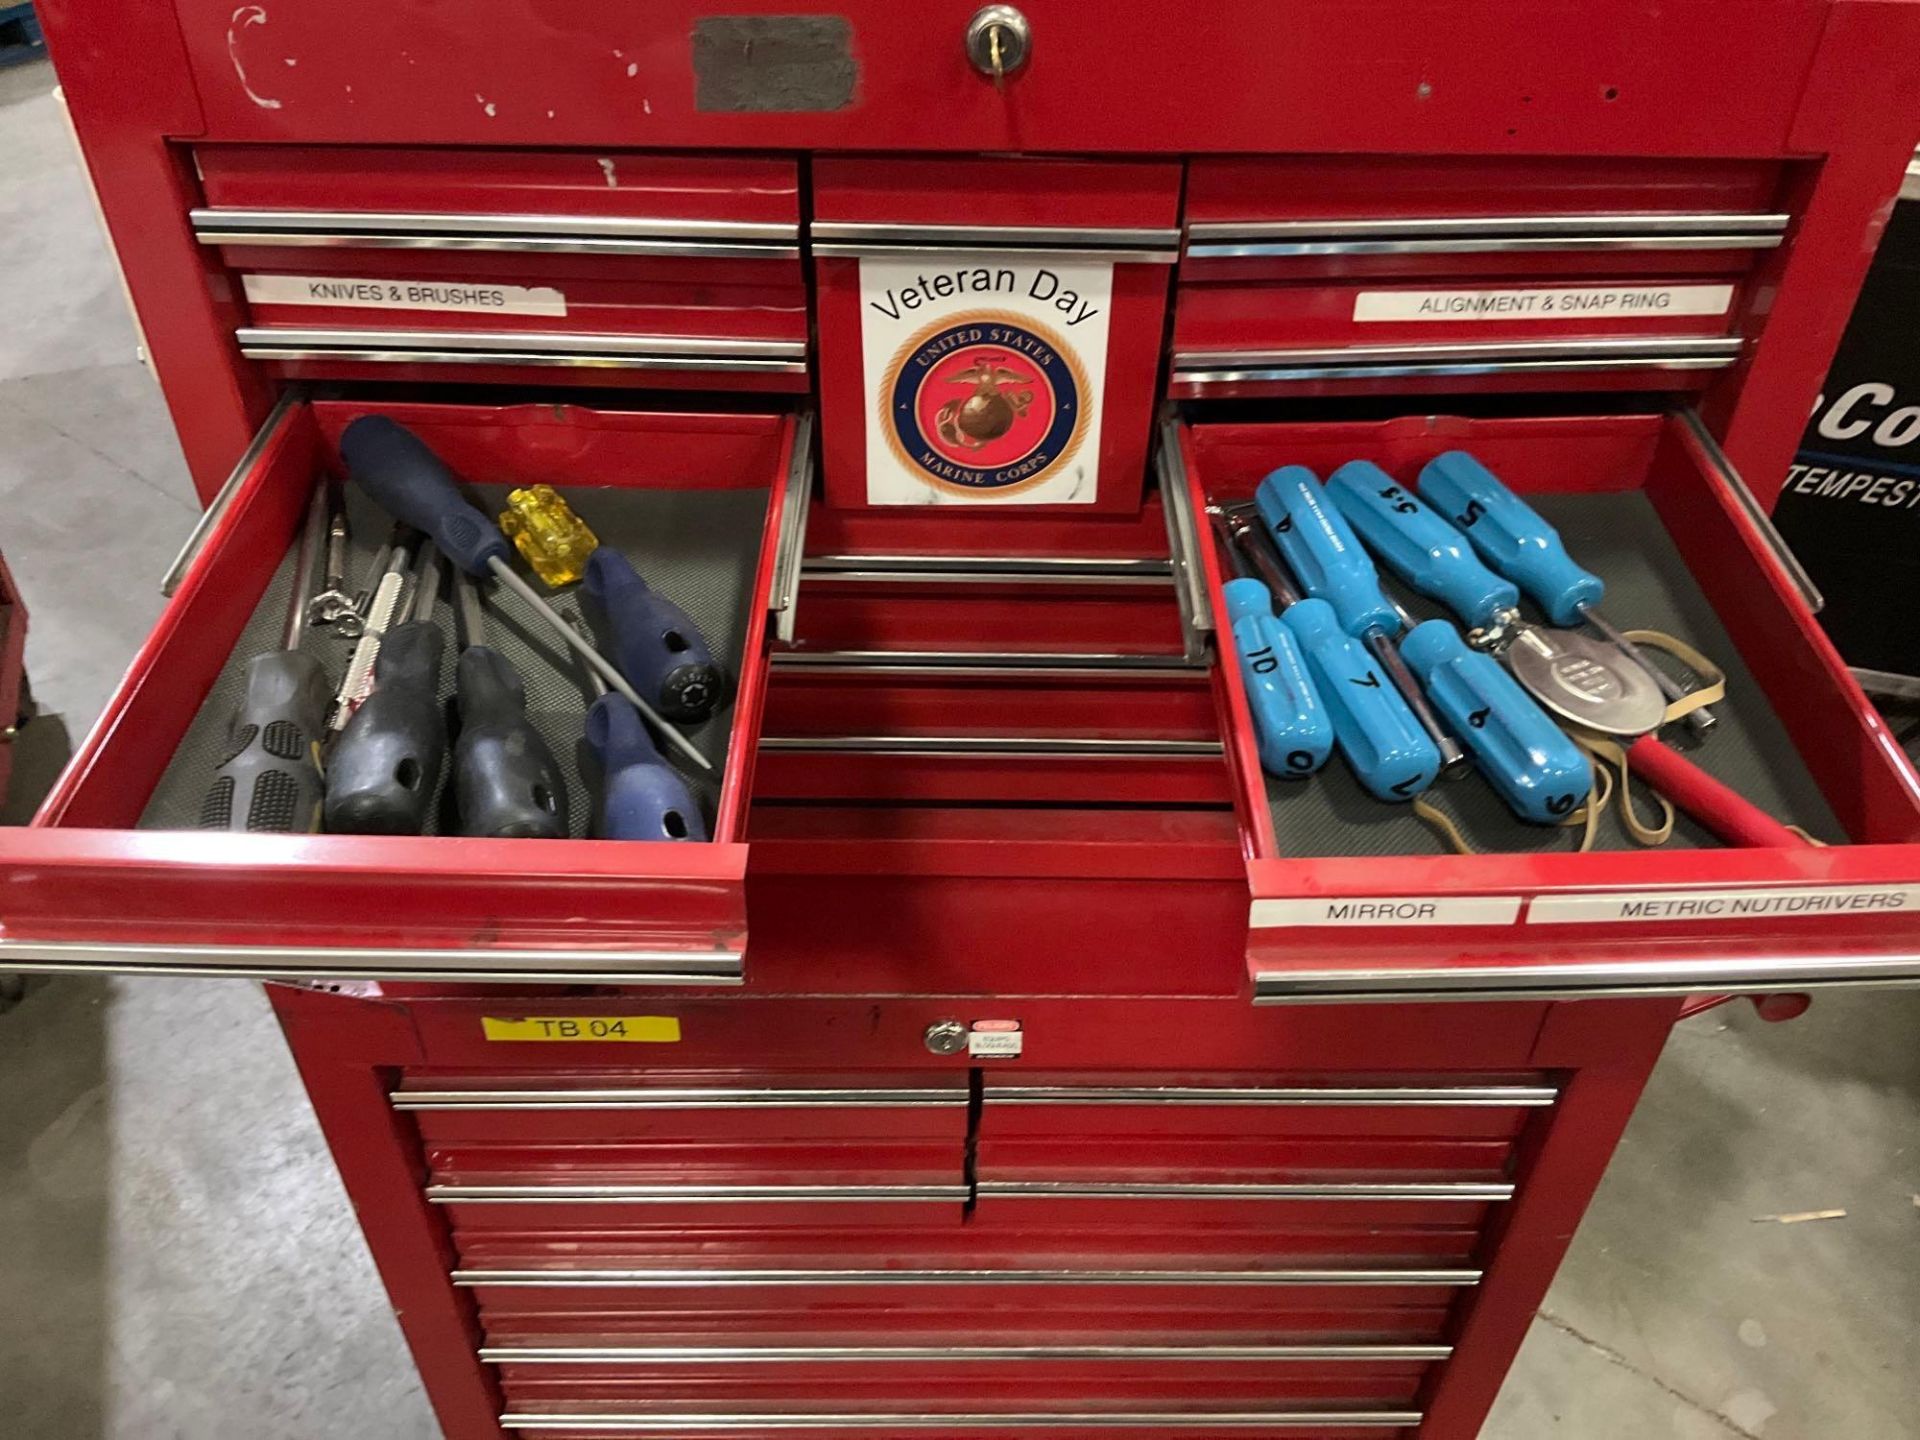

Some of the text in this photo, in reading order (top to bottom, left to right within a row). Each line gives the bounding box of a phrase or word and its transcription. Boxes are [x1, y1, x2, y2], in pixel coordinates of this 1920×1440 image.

[309, 283, 505, 307] KNIVES & BRUSHES
[871, 268, 1098, 326] Veteran Day
[1419, 292, 1671, 314] ALIGNMENT & SNAP RING
[916, 328, 1055, 367] UNITED STATES
[1811, 382, 1920, 447] Co
[919, 451, 1048, 484] MARINE CORPS
[1246, 646, 1279, 674] 10
[1348, 670, 1381, 688] 7
[1326, 903, 1437, 920] MIRROR
[1620, 891, 1907, 918] METRIC NUTDRIVERS
[534, 1020, 629, 1038] TB 04
